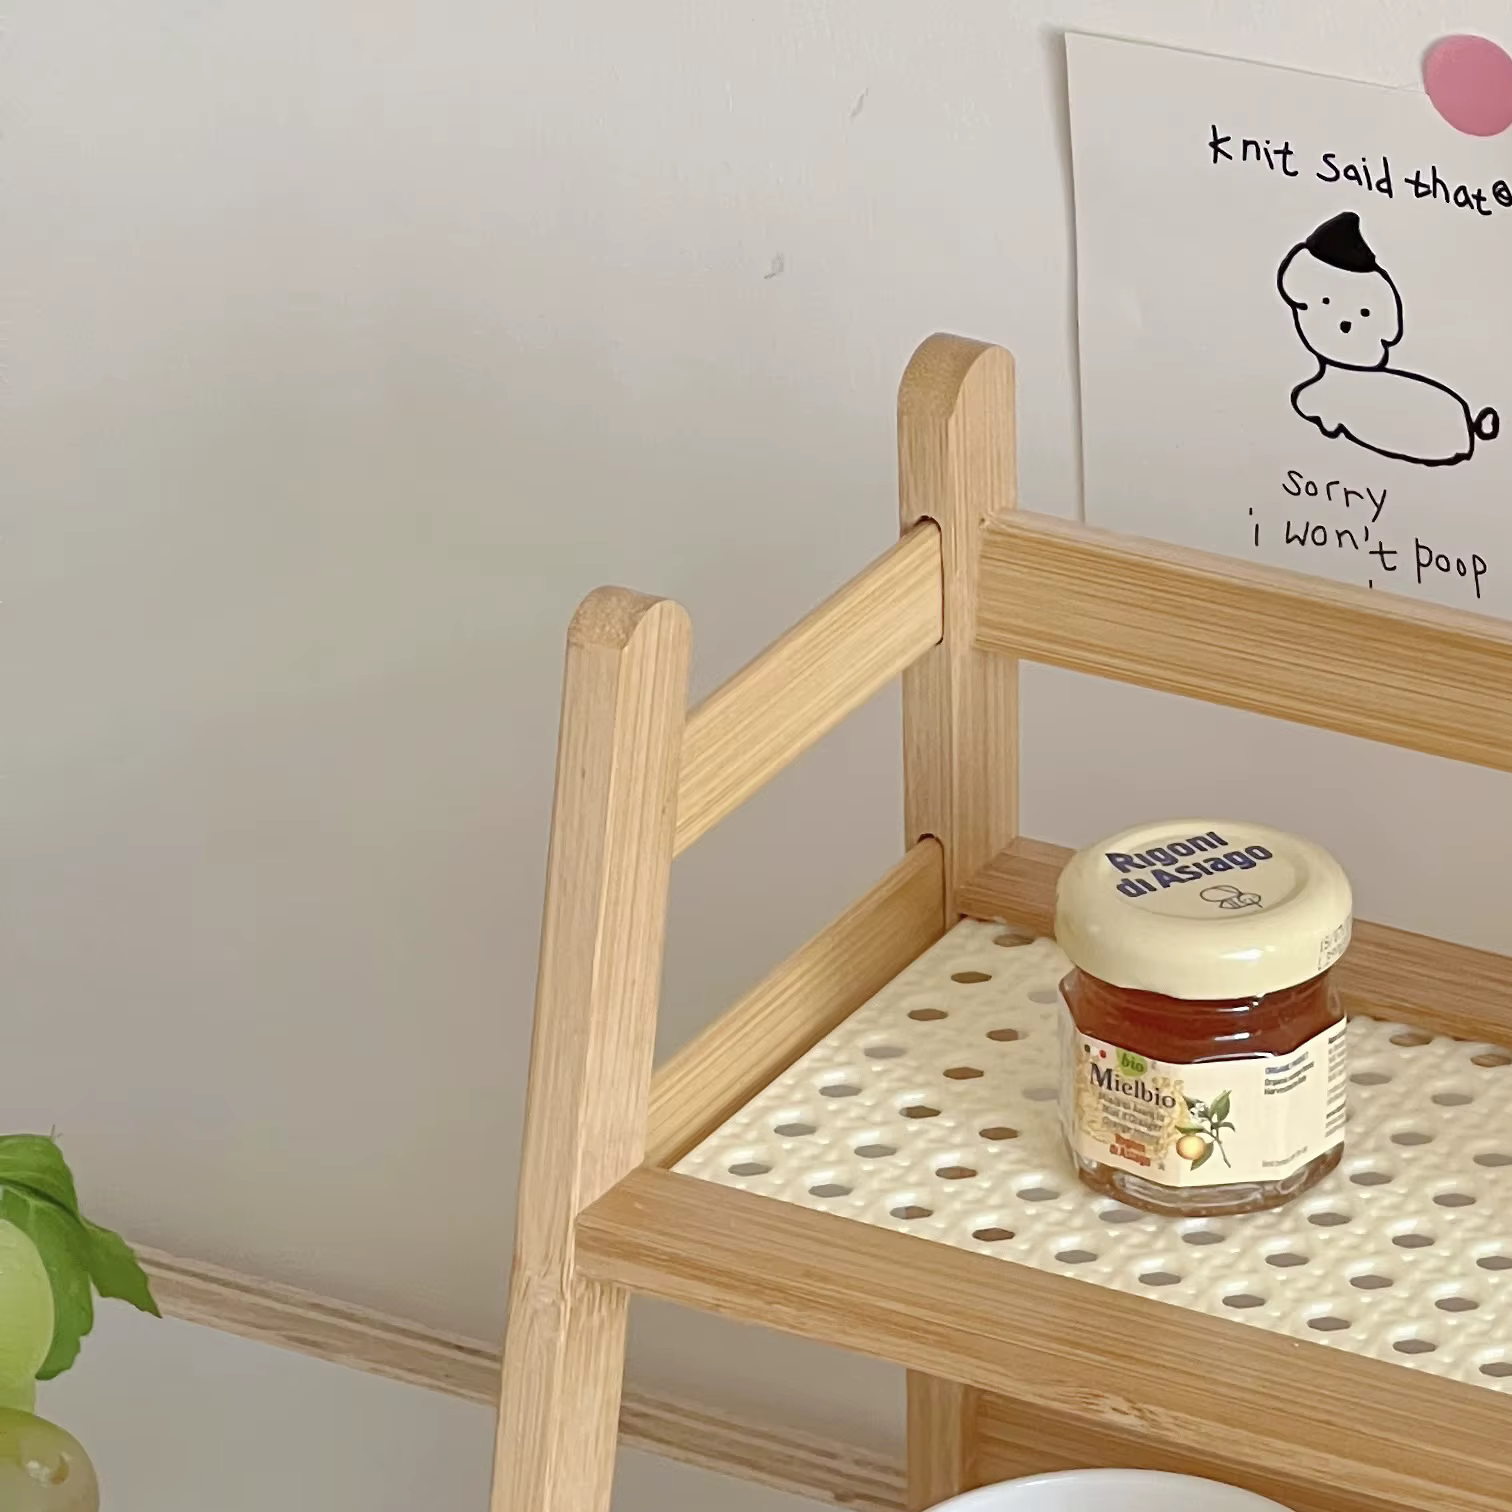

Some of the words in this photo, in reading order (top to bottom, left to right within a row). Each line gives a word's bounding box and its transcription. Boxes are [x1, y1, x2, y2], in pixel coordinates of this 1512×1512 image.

[1208, 124, 1300, 178] knit
[1285, 520, 1398, 572] won't
[1415, 537, 1488, 599] poop
[1105, 831, 1229, 873] Rigoni
[1116, 878, 1157, 897] di
[1150, 845, 1273, 888] Asiago
[1089, 1062, 1177, 1109] Mielbio
[1120, 1052, 1145, 1073] bio
